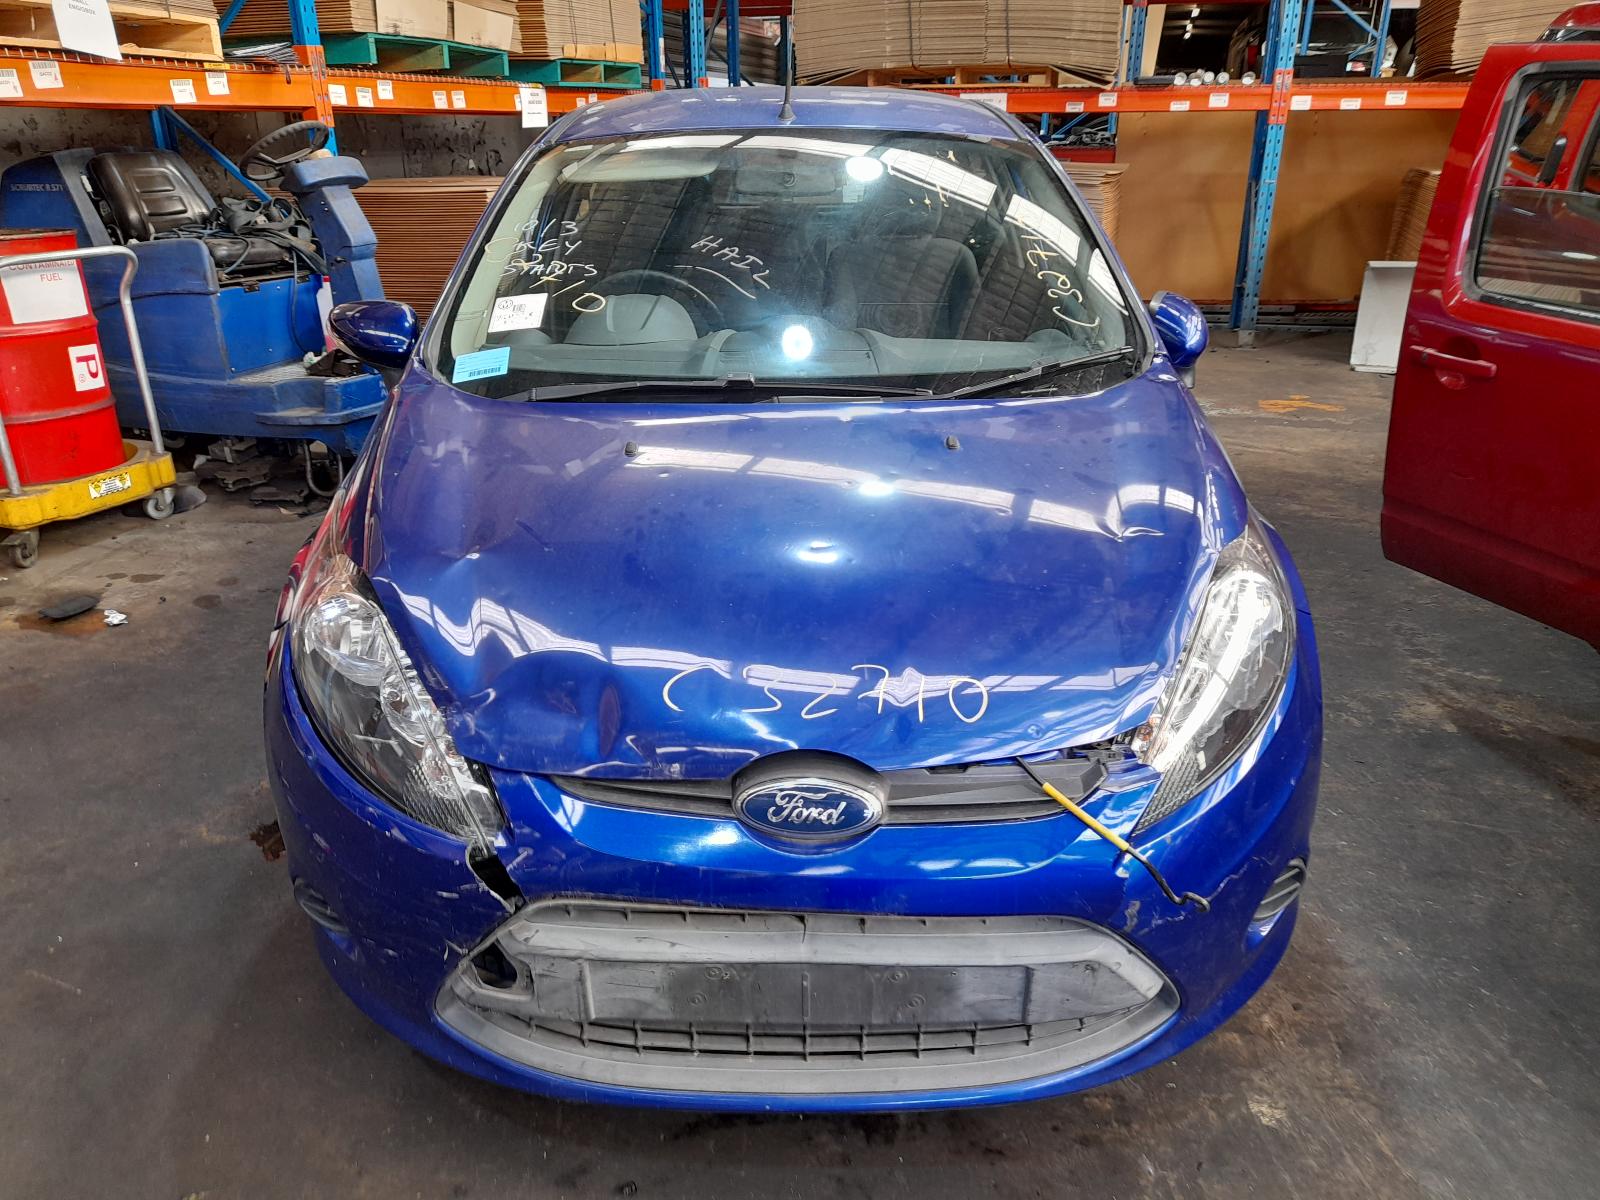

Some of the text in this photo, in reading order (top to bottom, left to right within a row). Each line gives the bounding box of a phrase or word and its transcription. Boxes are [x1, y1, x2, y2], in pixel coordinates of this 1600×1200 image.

[40, 273, 63, 282] FUEL
[690, 235, 771, 290] HAIL
[76, 354, 98, 379] P
[766, 790, 848, 826] Ford
